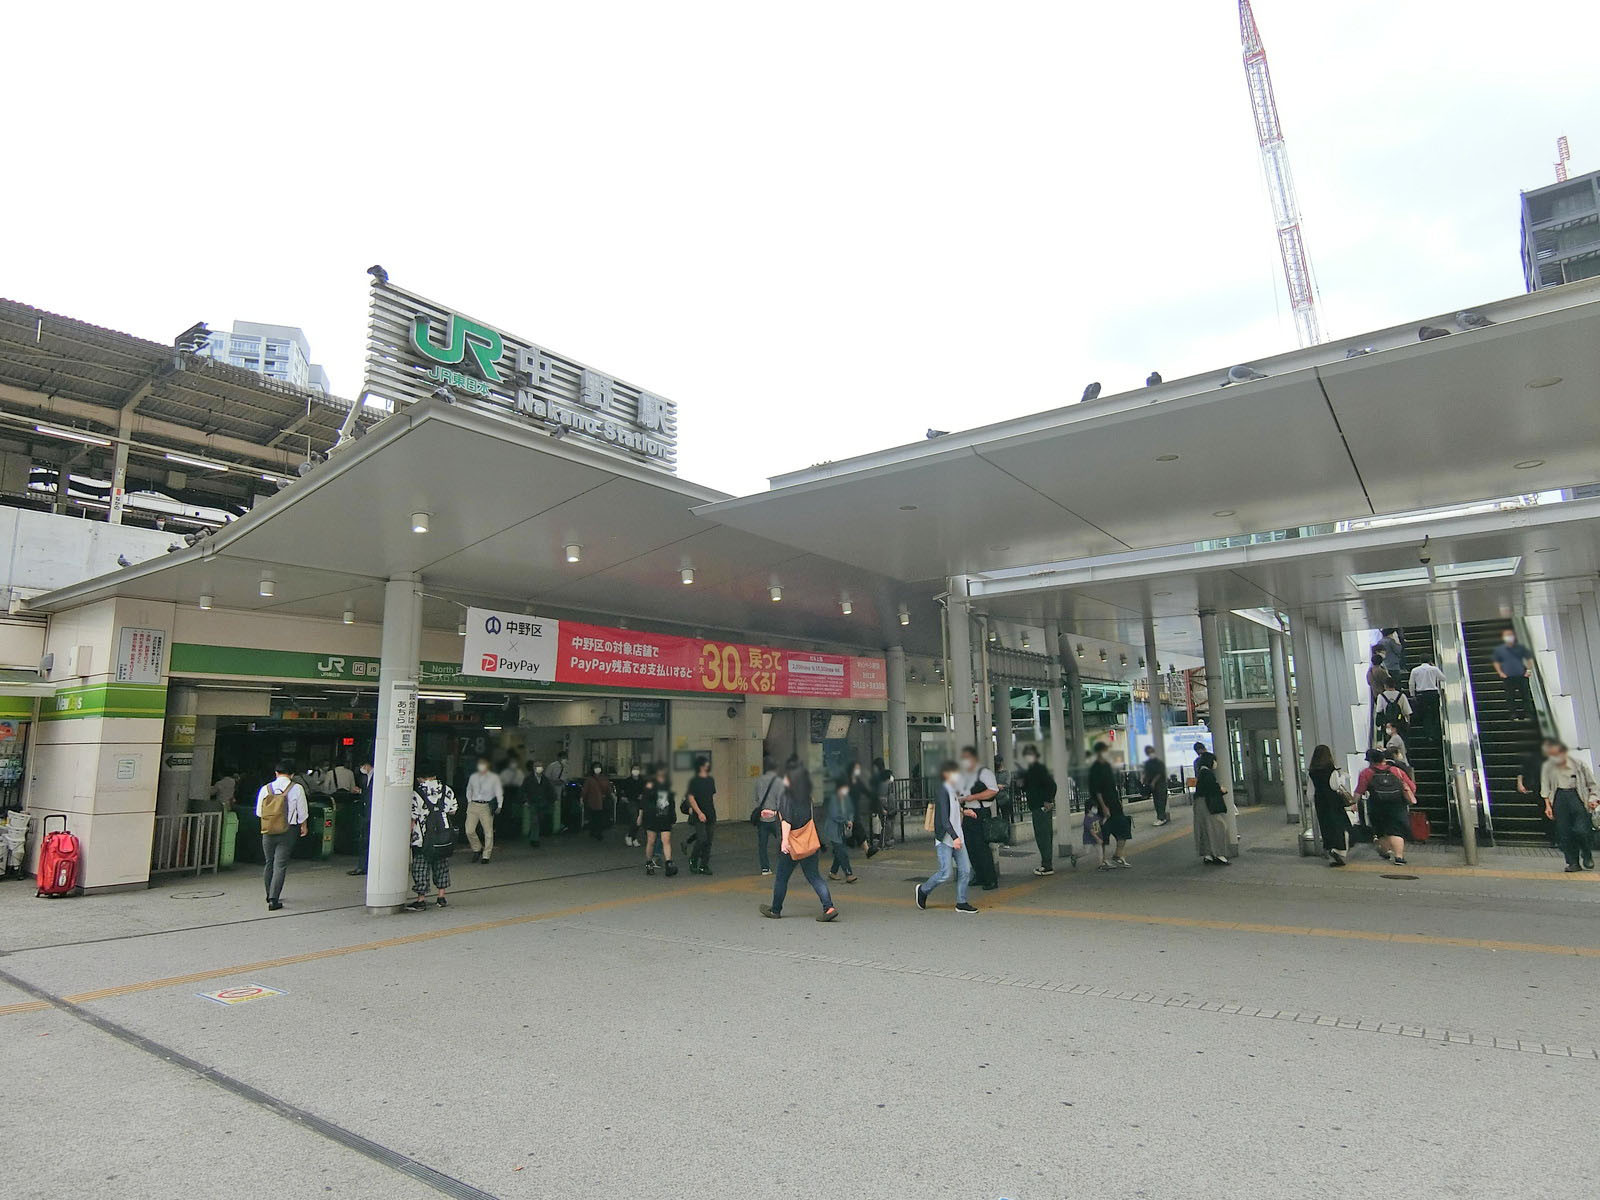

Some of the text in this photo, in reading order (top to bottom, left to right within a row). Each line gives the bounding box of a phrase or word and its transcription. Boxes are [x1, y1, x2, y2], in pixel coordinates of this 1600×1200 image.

[410, 314, 504, 384] JR
[427, 365, 489, 397] JR東日本
[516, 348, 668, 434] 中野駅
[517, 389, 667, 458] Nakano Station
[506, 621, 543, 637] 中野区
[571, 636, 659, 657] 中野区の対象店舗で
[317, 656, 345, 673] JR
[431, 664, 454, 674] North
[499, 658, 540, 674] PayPay
[570, 656, 693, 678] PayPay残高でお支払いすると
[748, 648, 782, 671] 戻って
[397, 701, 407, 723] あちら
